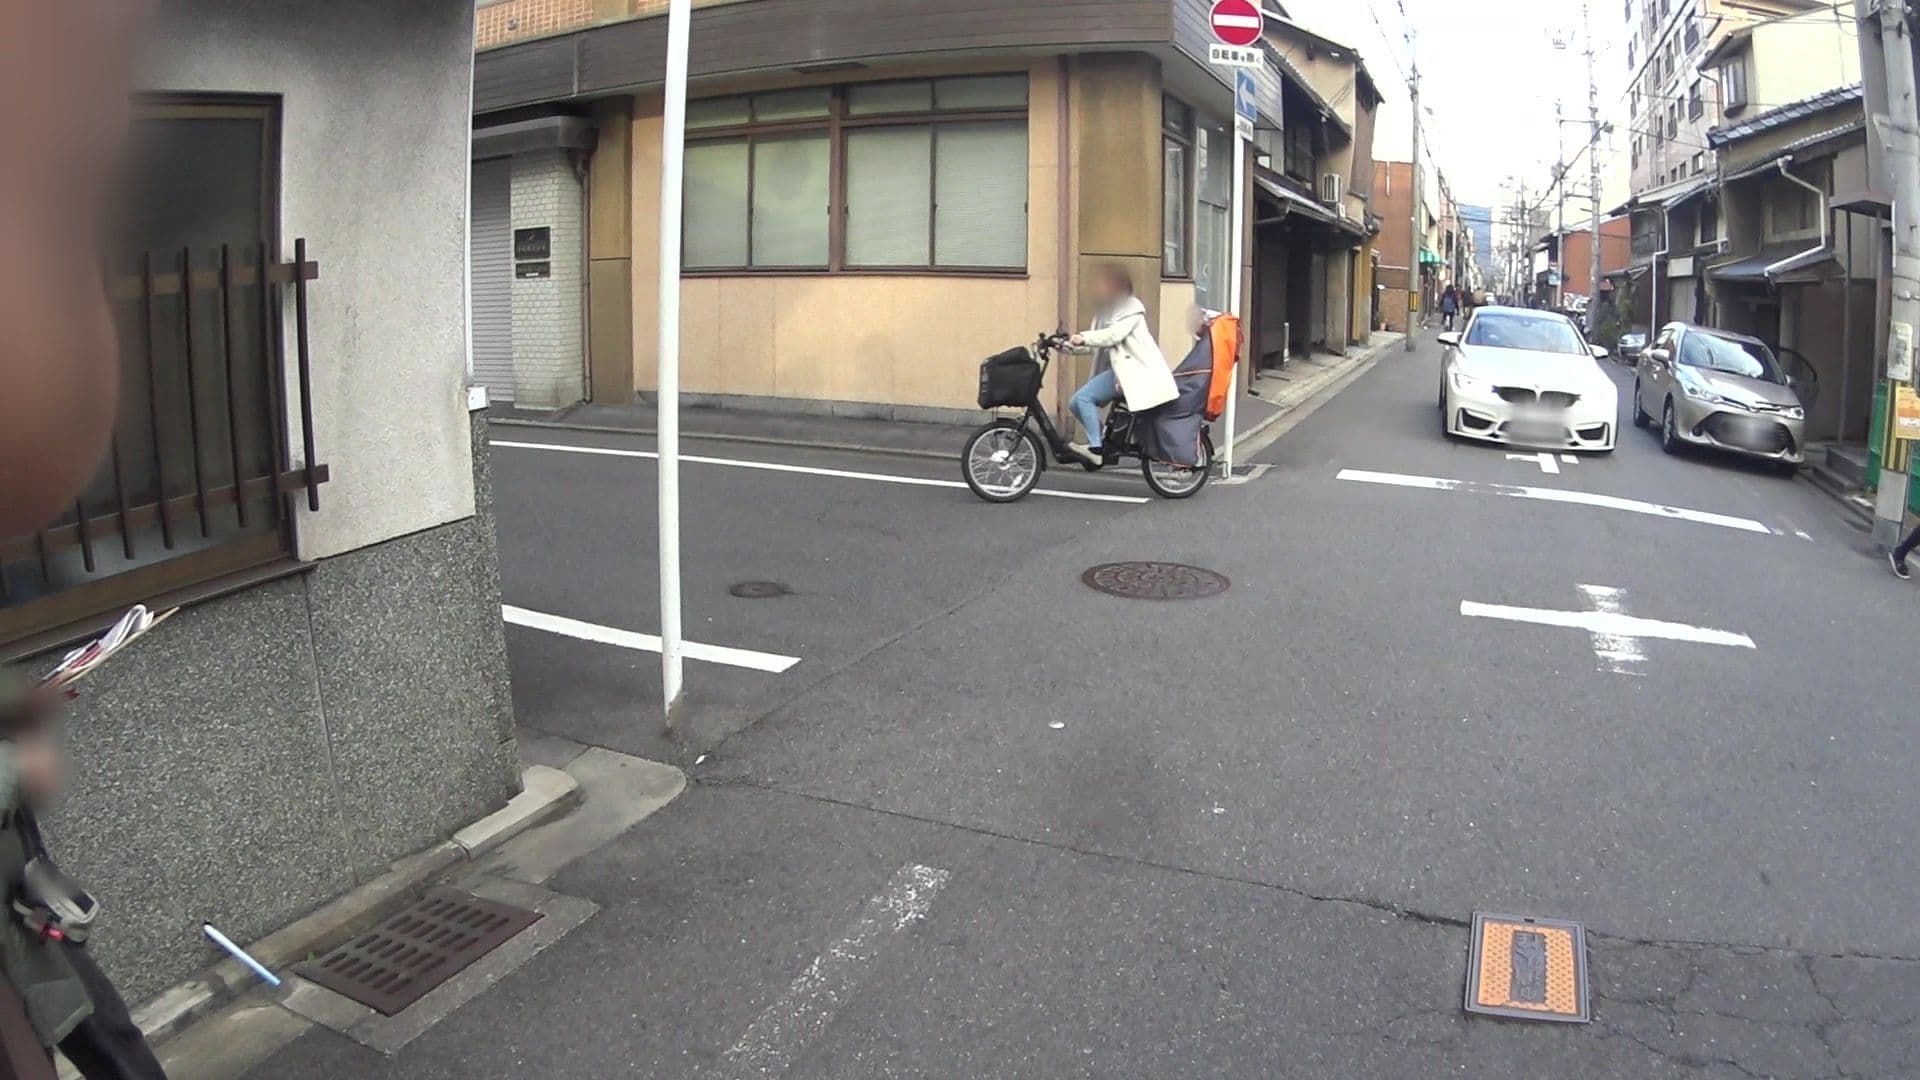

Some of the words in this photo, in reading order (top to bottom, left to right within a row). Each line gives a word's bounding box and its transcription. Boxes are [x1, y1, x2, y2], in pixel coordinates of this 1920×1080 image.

[1212, 49, 1260, 62] 自転車を除く
